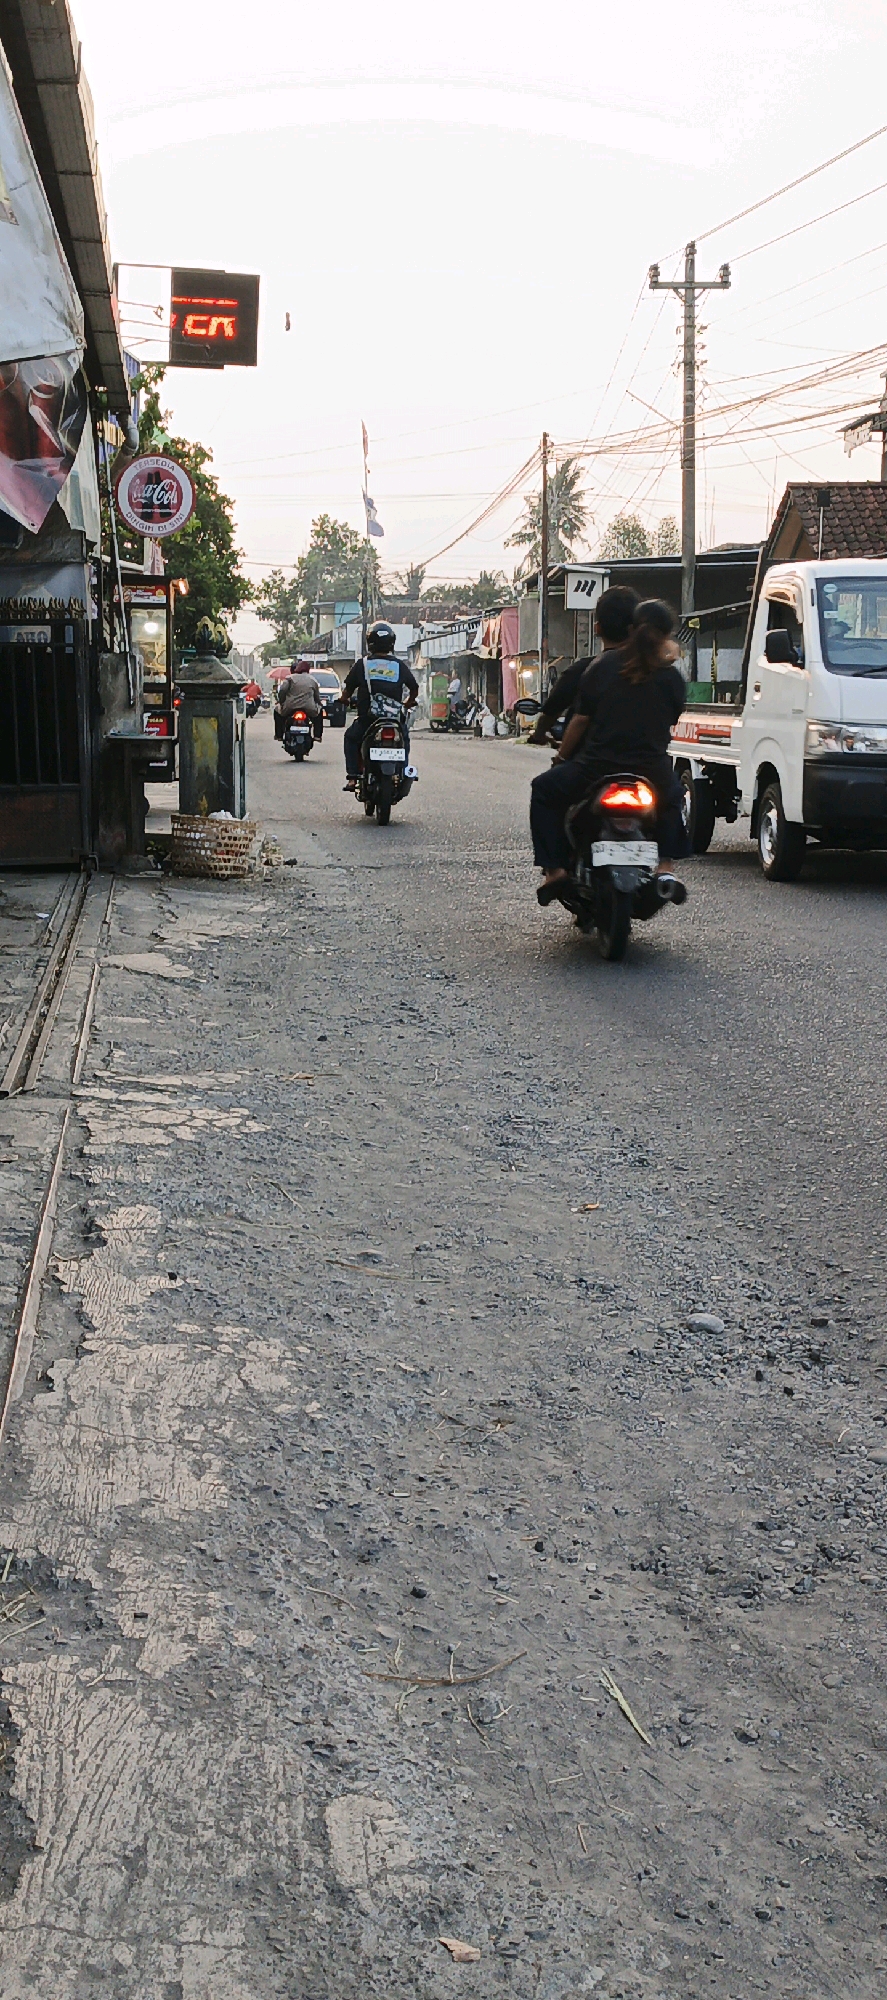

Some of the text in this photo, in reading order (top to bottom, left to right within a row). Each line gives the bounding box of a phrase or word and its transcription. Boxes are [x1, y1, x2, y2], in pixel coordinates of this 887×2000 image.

[133, 458, 175, 471] TERSEDIA
[157, 524, 168, 532] DI
[168, 512, 185, 527] SINI
